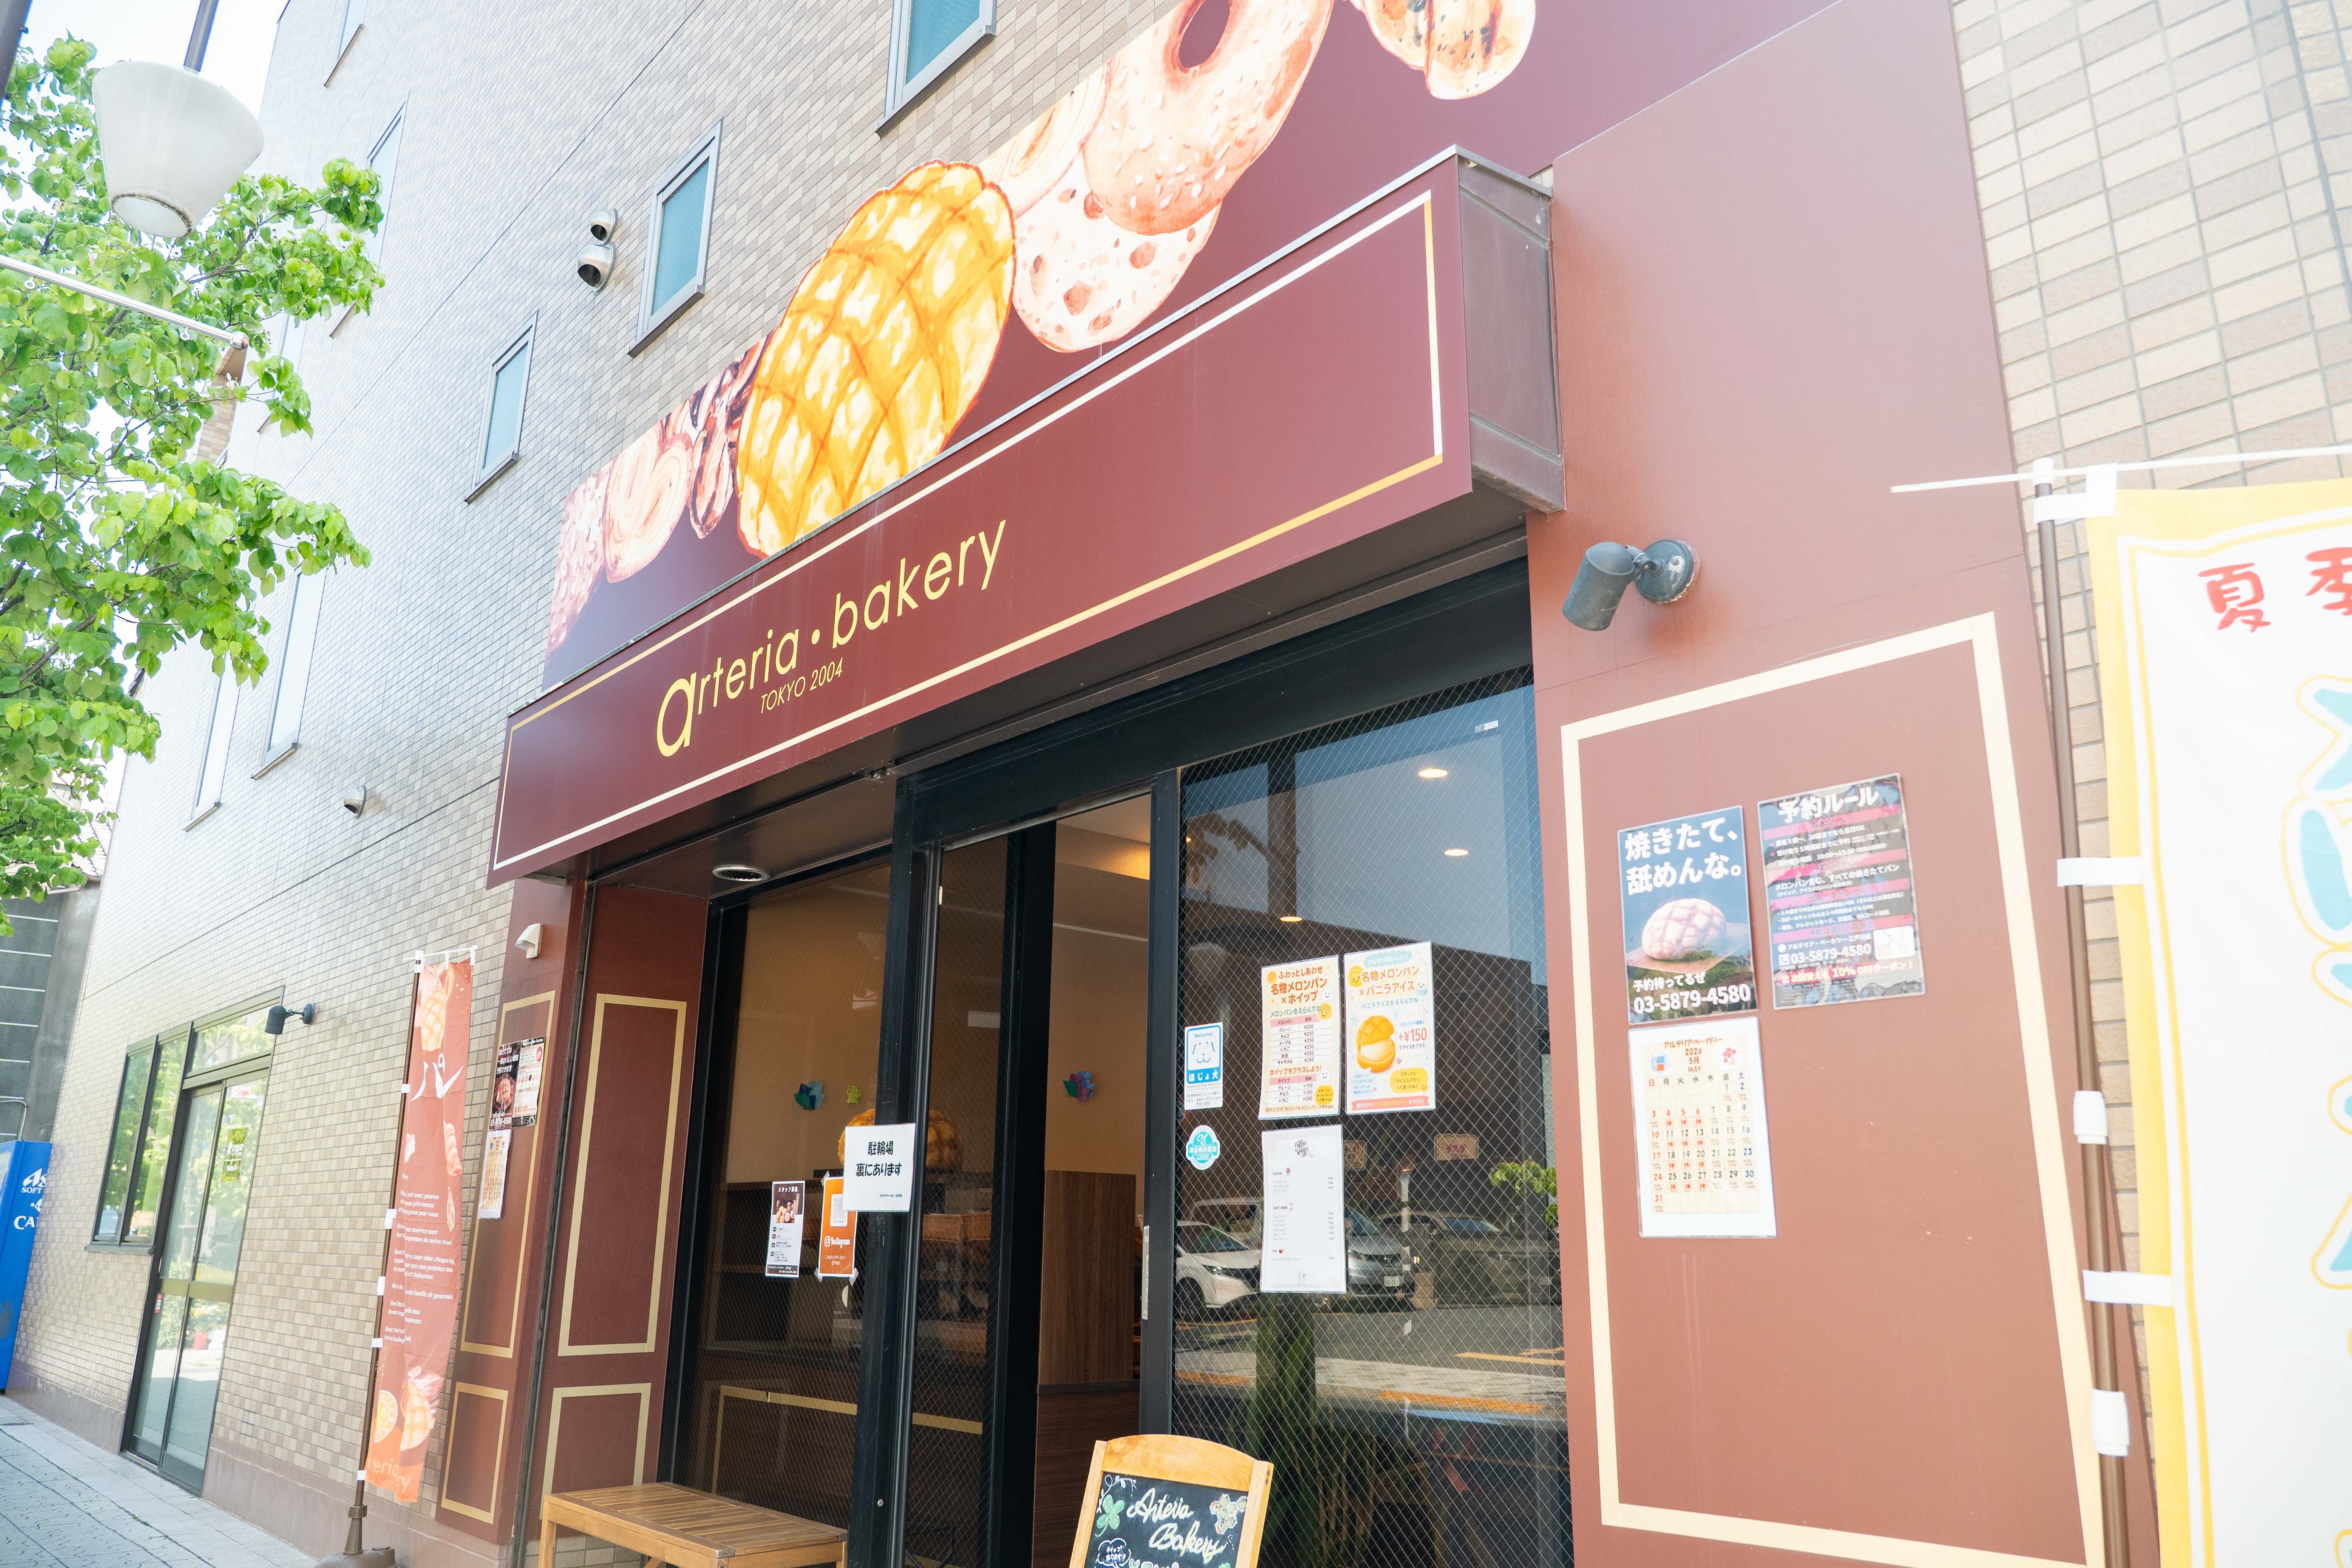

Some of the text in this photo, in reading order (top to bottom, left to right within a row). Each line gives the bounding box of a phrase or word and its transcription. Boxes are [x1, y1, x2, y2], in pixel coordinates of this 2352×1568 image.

[656, 519, 1006, 758] arteria bakery
[760, 657, 843, 714] TOKYO 2004
[1778, 787, 1879, 823] 予約ルール
[1625, 817, 1738, 861] 焼きたて、
[1626, 852, 1741, 895] 舐めんな。
[1790, 943, 1872, 964] 03-5879-4580
[1278, 966, 1323, 979] ふわっとしあわせ
[1362, 966, 1419, 982] 名物メロンパン
[1833, 966, 1856, 977] 10%
[1271, 977, 1327, 995] 名物メロンパン
[1633, 971, 1706, 992] 予約待ってるぜ
[1361, 997, 1418, 1009] バニラアイスをえらんでね
[1634, 983, 1751, 1014] 03-5879-4580
[1270, 1005, 1322, 1017] メロンパンをえらんでね
[1398, 1028, 1427, 1042] +¥150
[1689, 1056, 1700, 1064] 5月
[1189, 1070, 1218, 1082] ほじょ犬
[868, 1141, 894, 1156] 駐輪場
[856, 1162, 902, 1177] 裏にあります
[14, 1216, 39, 1230] CA
[831, 1237, 851, 1248] Instagram
[1126, 1488, 1194, 1523] Arteria
[1149, 1520, 1228, 1564] Bakery
